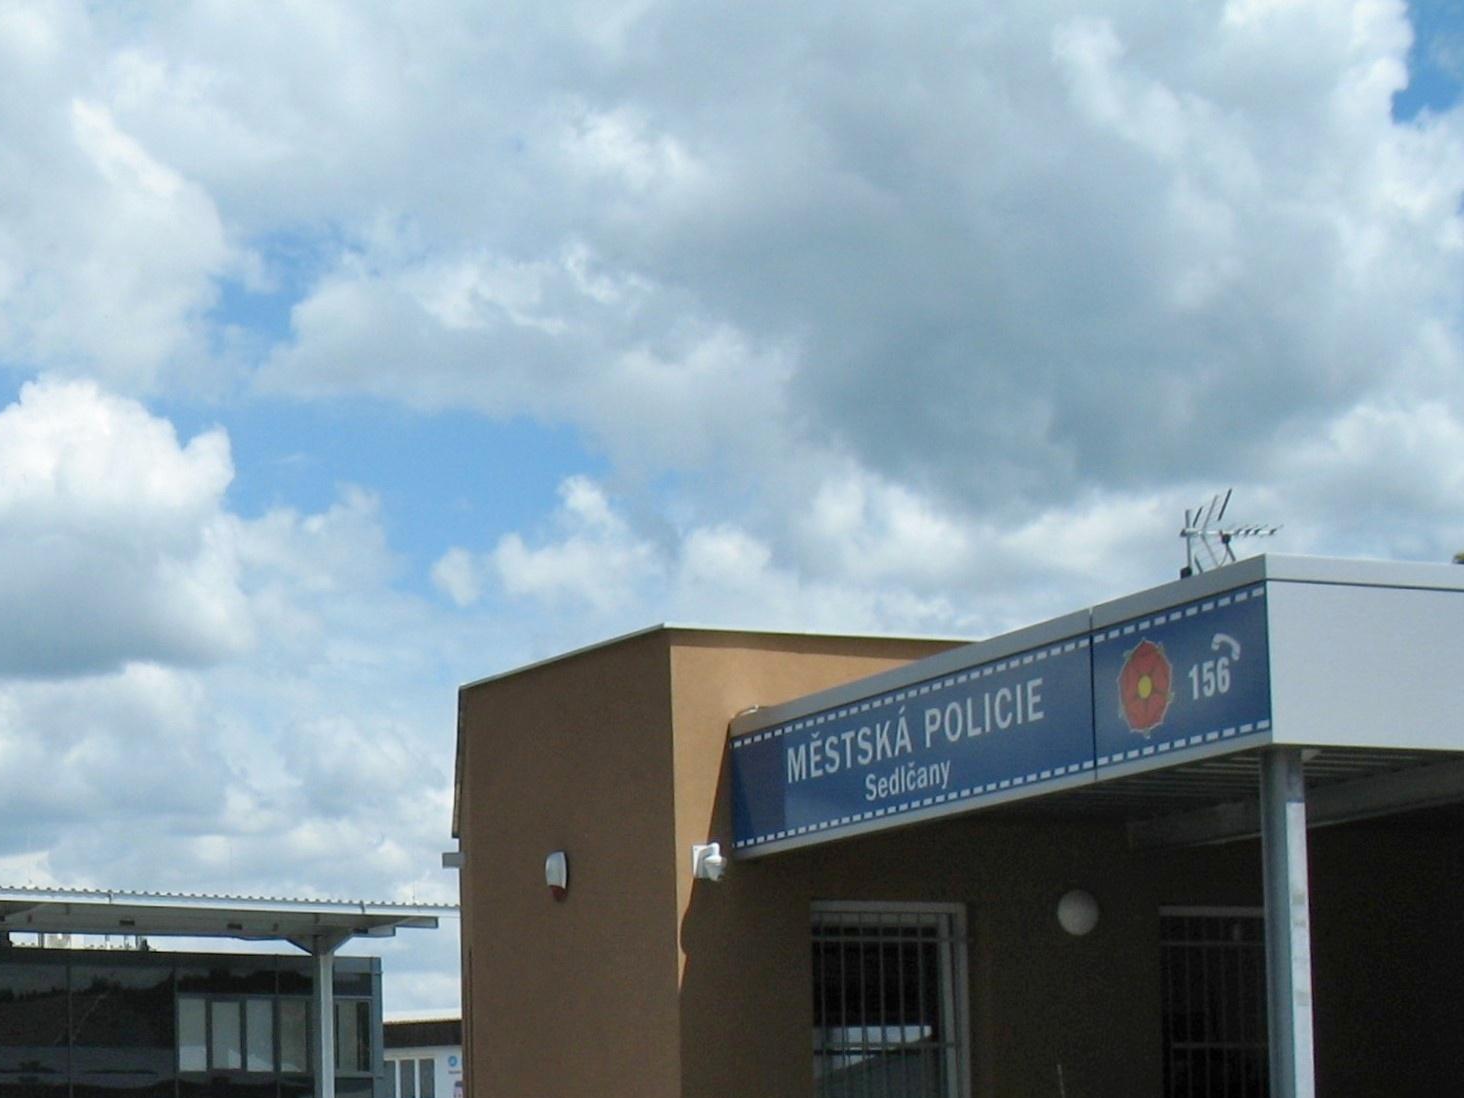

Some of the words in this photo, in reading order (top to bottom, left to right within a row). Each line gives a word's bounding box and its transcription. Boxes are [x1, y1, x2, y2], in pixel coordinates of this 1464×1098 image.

[1188, 656, 1230, 700] 156
[787, 705, 913, 784] MĚSTSKÁ
[925, 678, 1044, 748] POLICIE
[865, 760, 951, 801] Sedlčany
